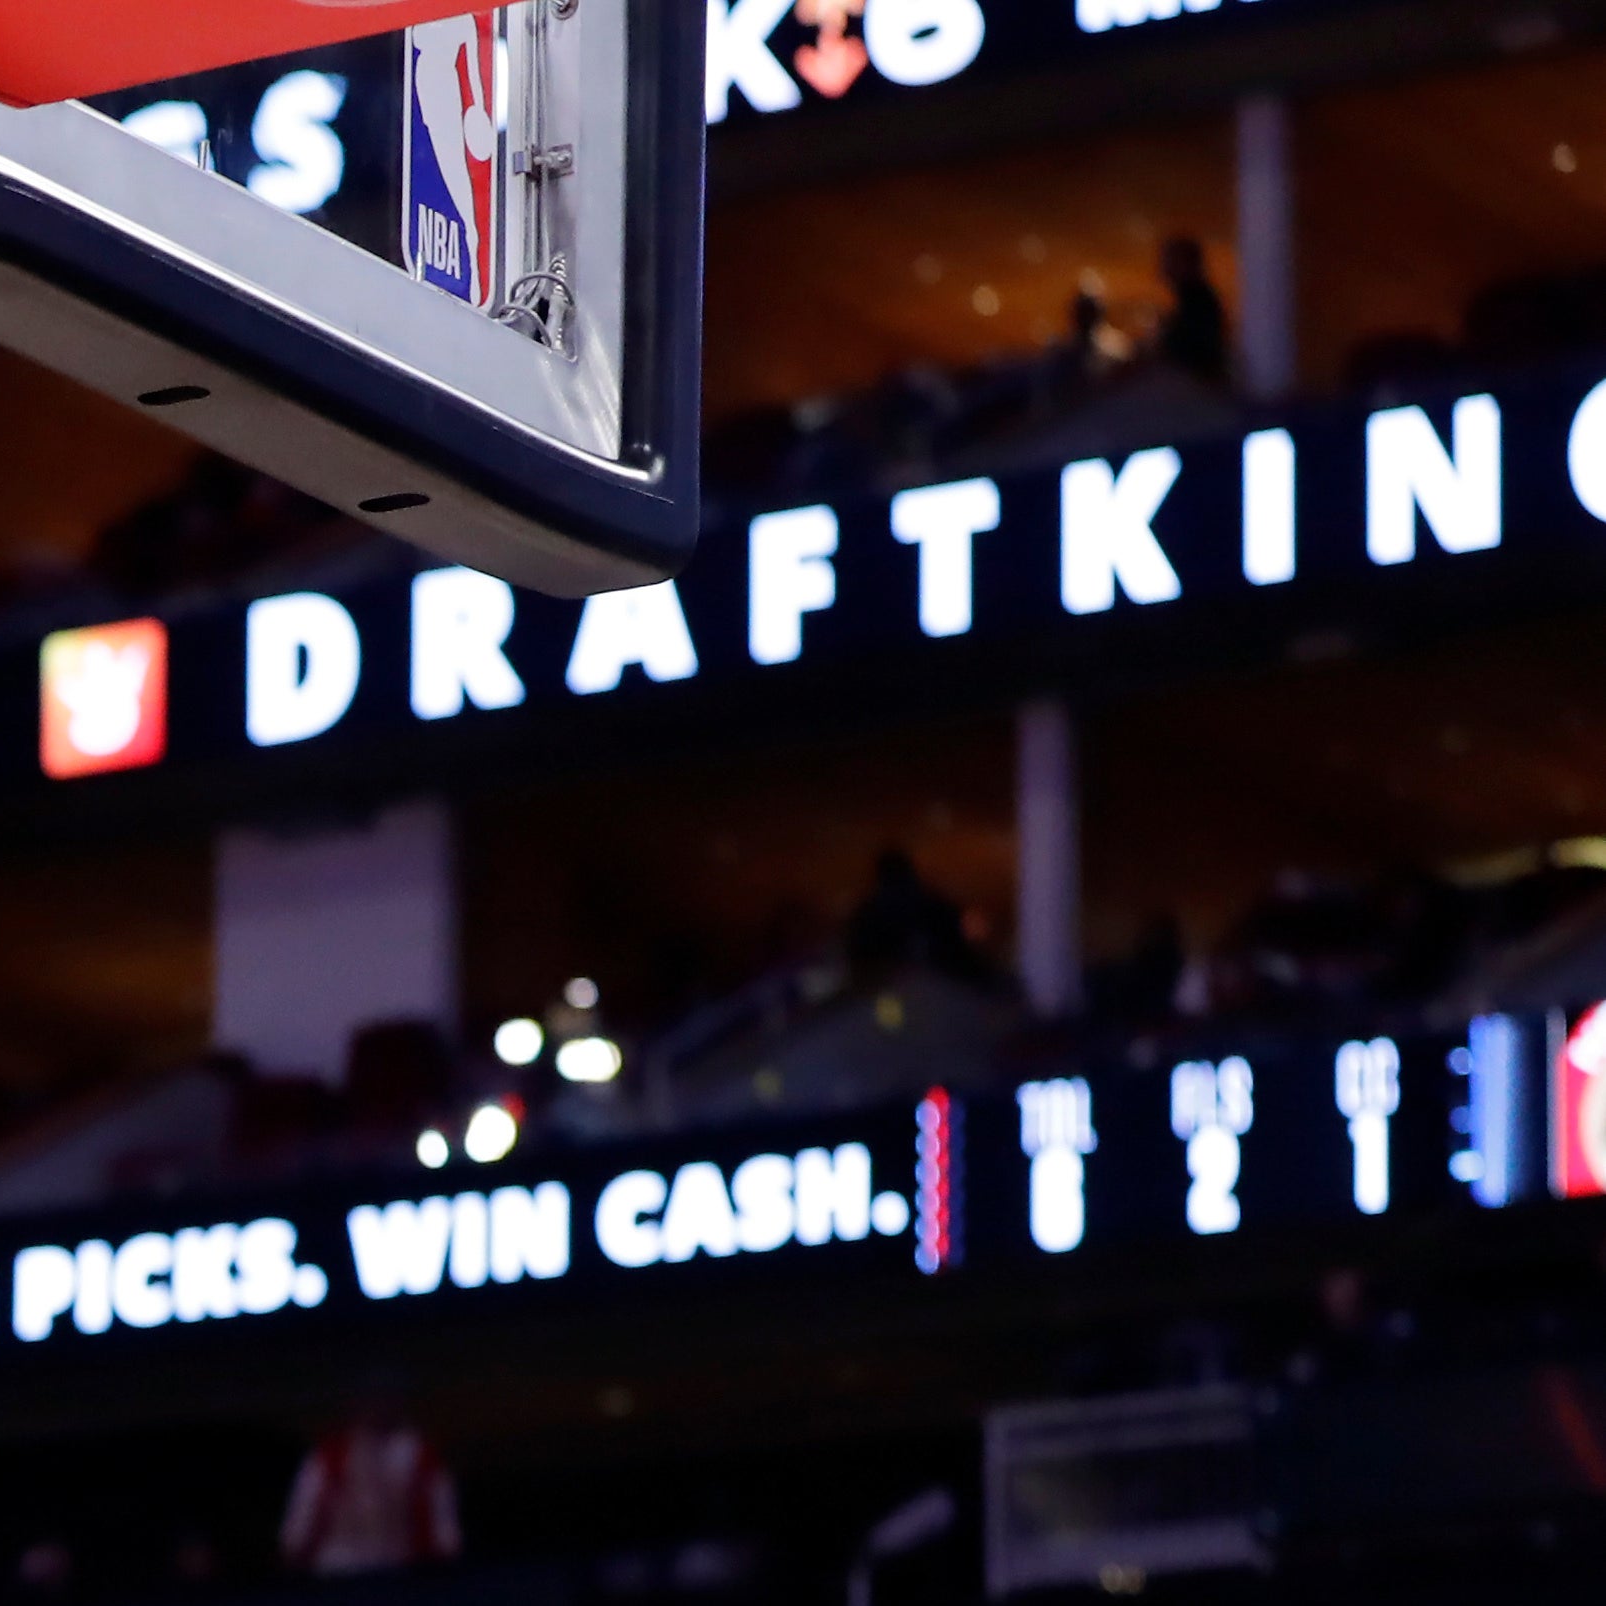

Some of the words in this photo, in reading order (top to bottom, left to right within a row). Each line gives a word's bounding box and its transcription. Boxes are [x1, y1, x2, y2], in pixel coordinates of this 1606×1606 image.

[417, 203, 462, 280] NBA
[1186, 1127, 1241, 1234] 2
[1349, 1111, 1389, 1214] 1
[12, 1218, 327, 1342] PICKS.
[347, 1181, 571, 1300] WIN
[594, 1142, 909, 1268] CASH.
